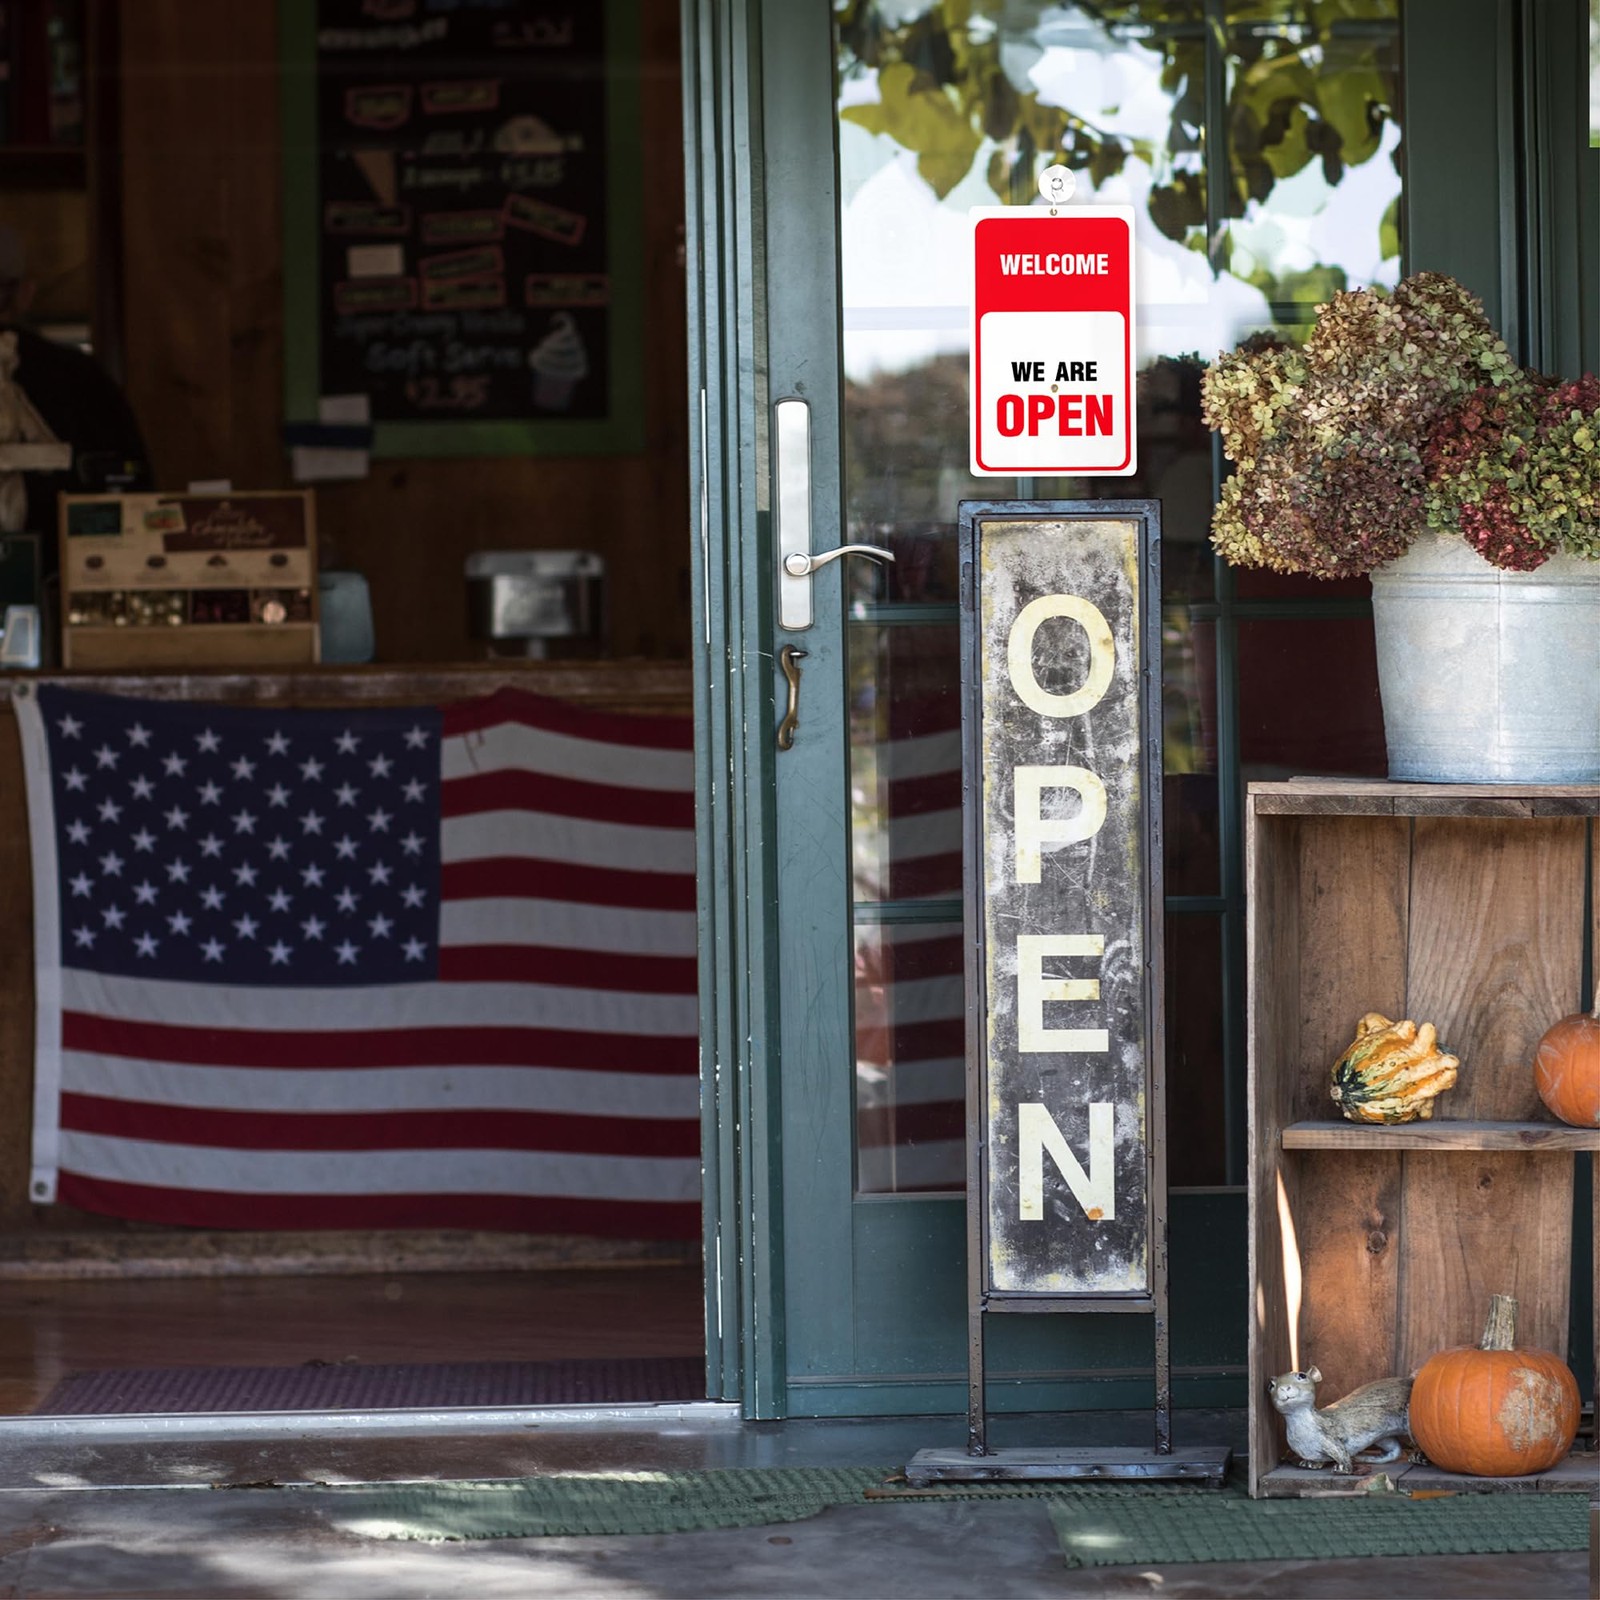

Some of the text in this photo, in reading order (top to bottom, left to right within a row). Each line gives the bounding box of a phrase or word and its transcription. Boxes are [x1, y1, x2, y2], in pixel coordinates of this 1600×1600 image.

[1000, 254, 1108, 275] WELCOME
[1011, 361, 1098, 382] WE ARE
[996, 394, 1114, 437] OPEN
[1008, 594, 1115, 1220] OPEN
